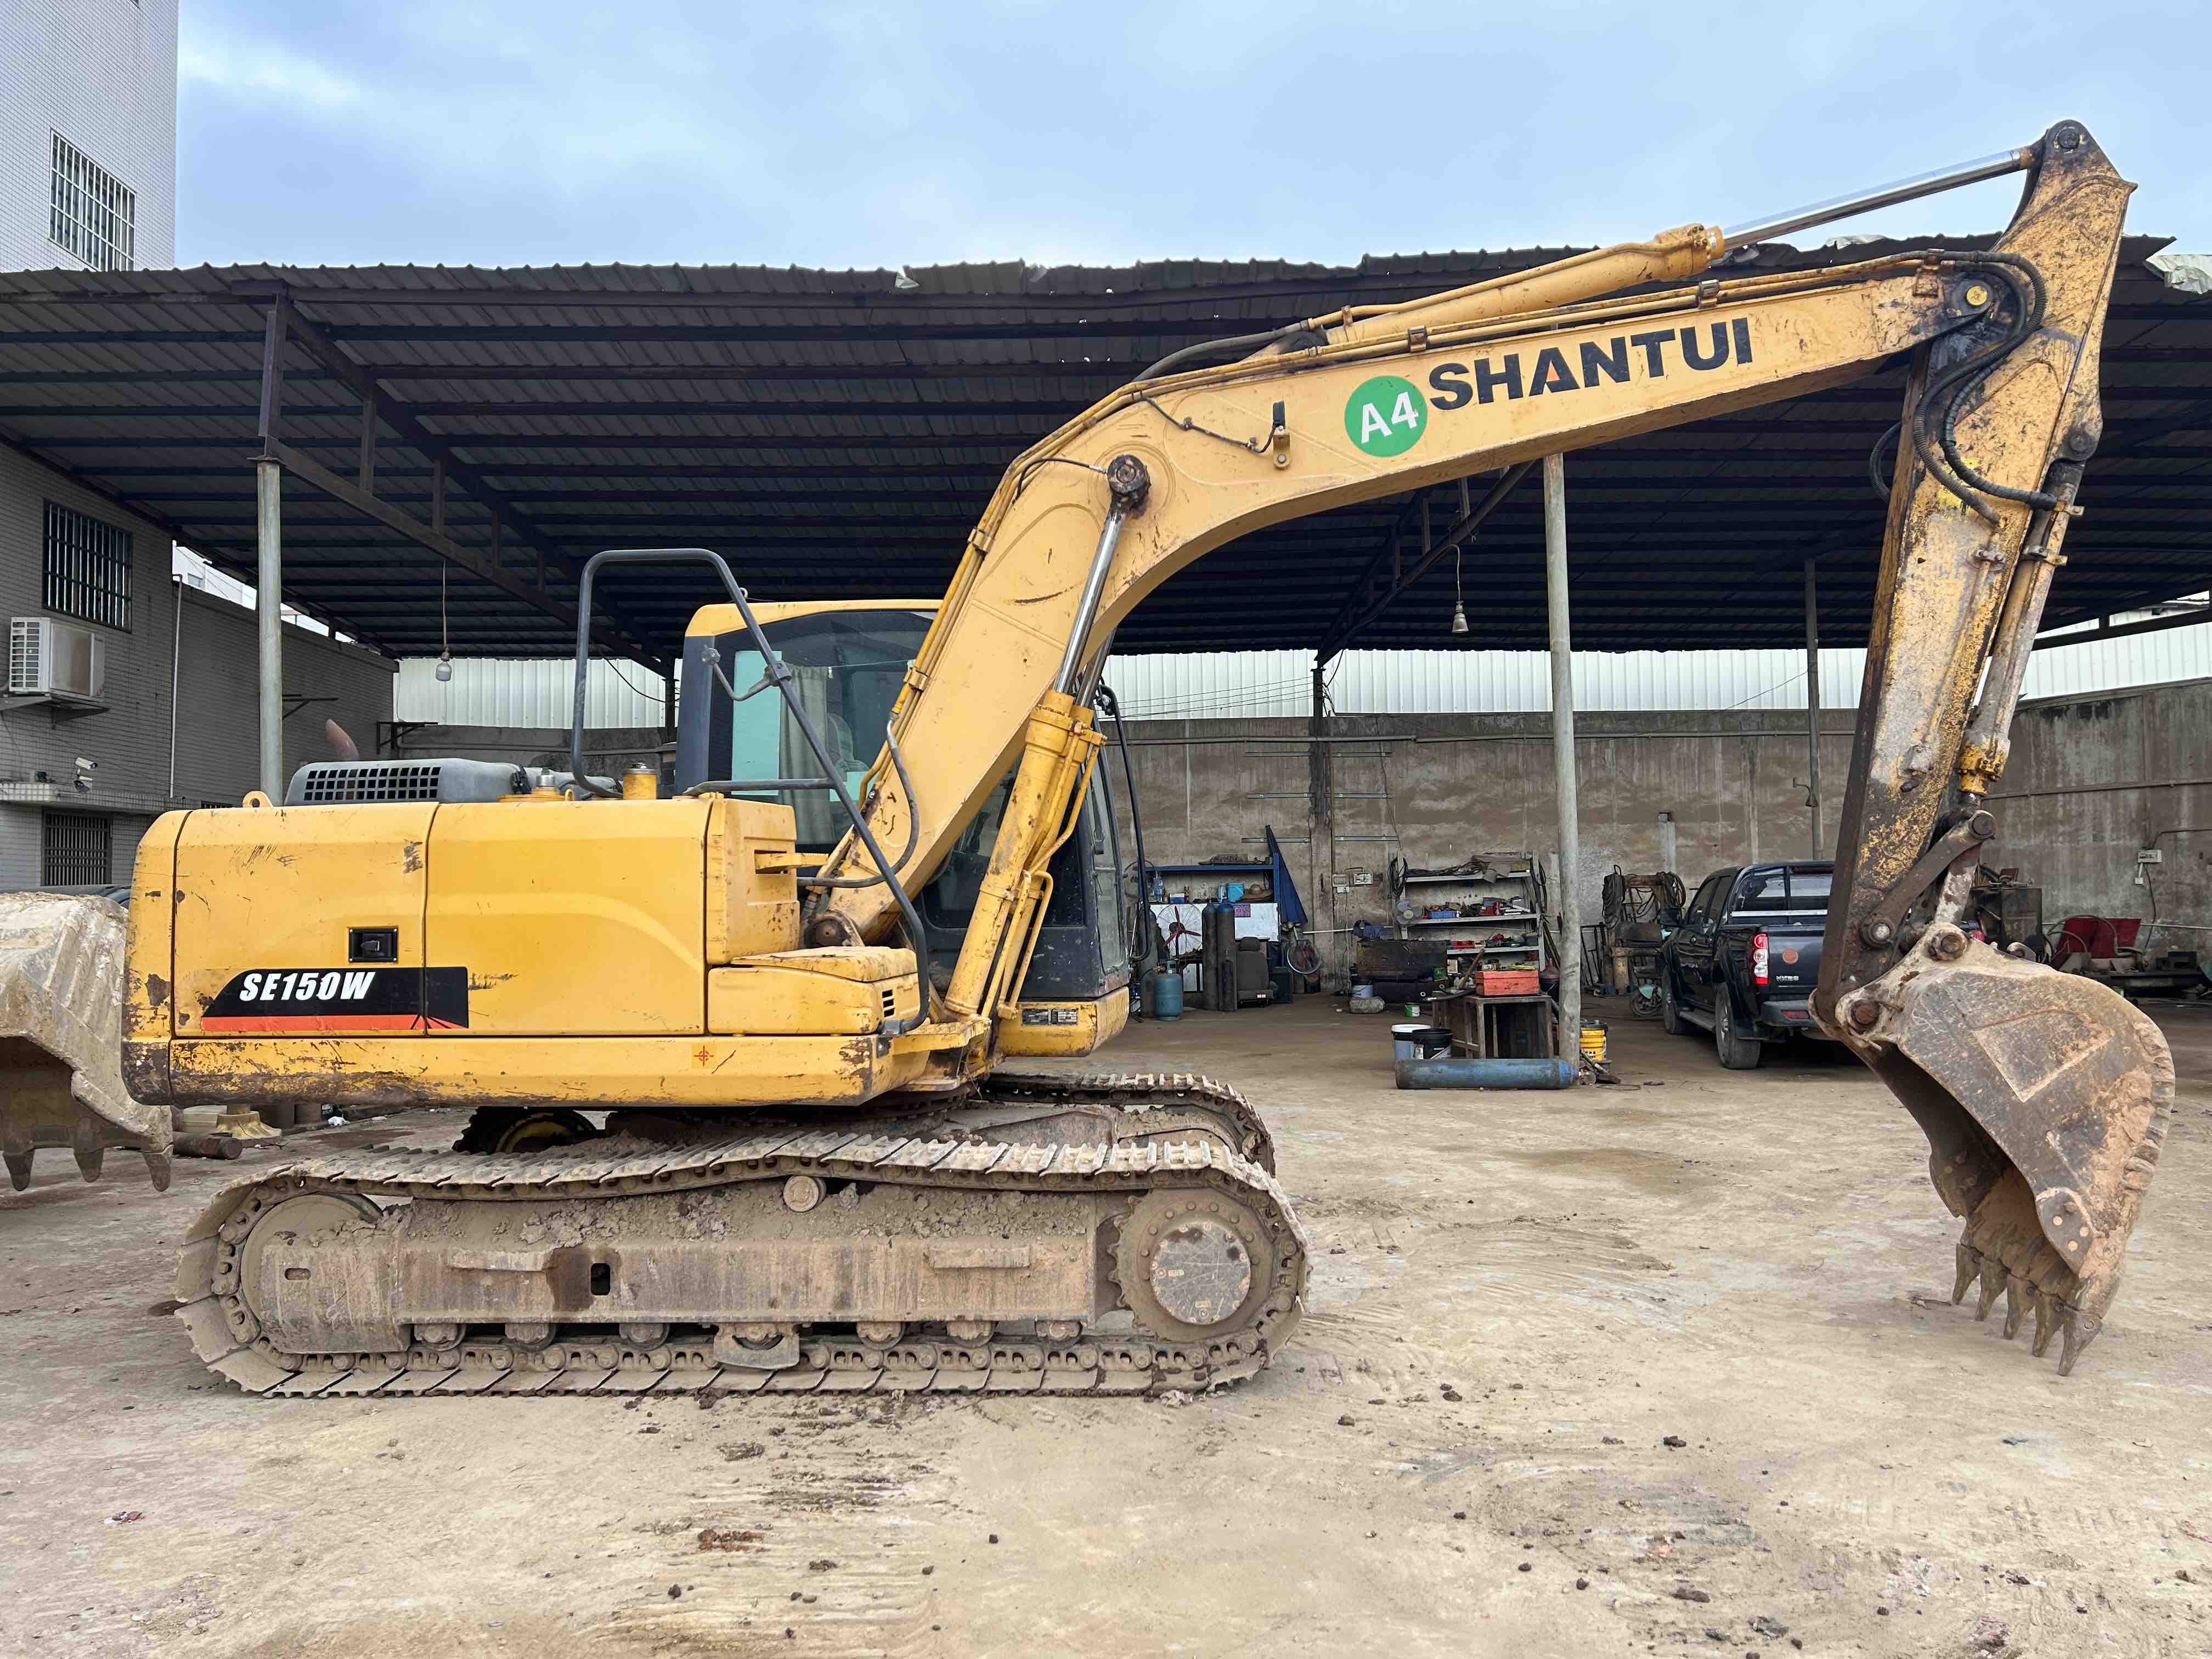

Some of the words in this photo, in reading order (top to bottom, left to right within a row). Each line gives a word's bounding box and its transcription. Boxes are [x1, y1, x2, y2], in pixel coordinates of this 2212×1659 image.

[1429, 317, 1753, 411] SHANTUI
[1361, 391, 1419, 444] A4
[239, 971, 376, 1001] SE150W
